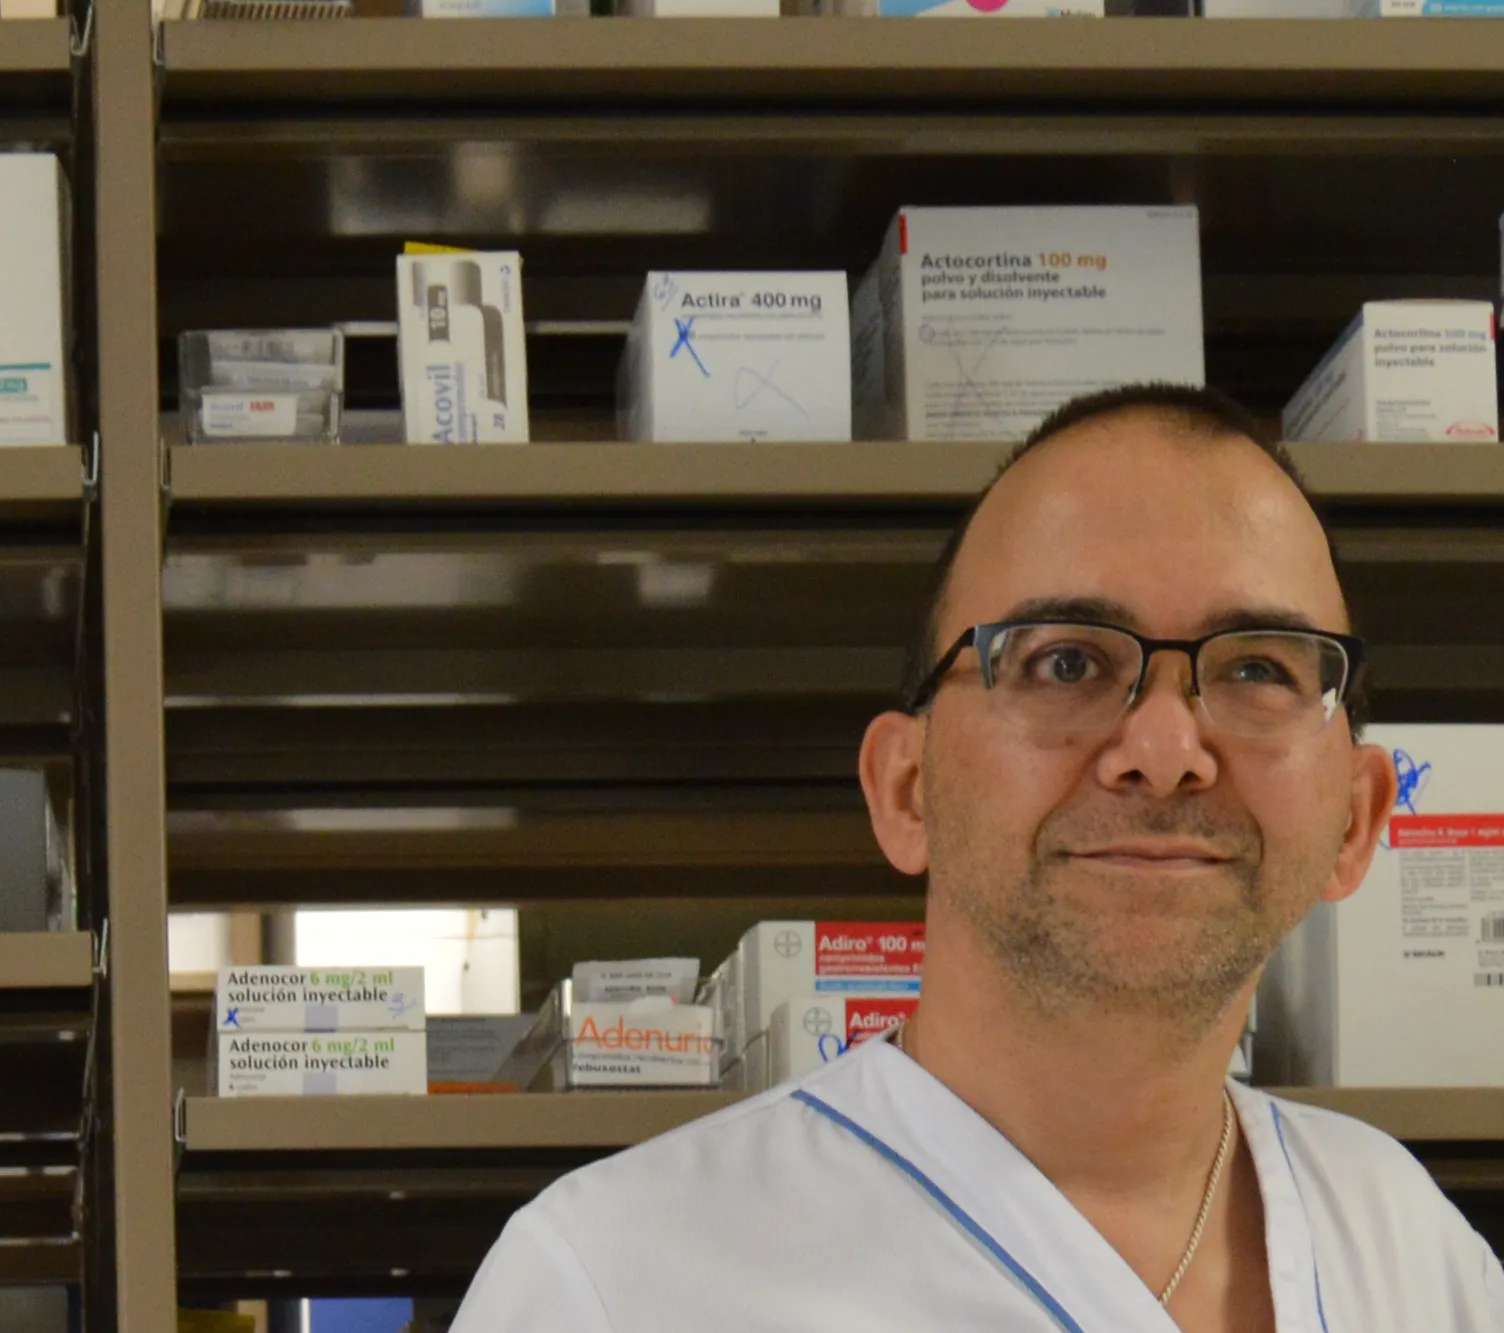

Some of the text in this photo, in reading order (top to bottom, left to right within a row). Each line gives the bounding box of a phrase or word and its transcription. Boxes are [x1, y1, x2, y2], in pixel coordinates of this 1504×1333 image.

[921, 251, 1108, 273] Actocortina 100 mg
[921, 272, 960, 287] polvo
[981, 270, 1060, 285] disolvente
[751, 293, 786, 309] 400
[790, 296, 823, 313] mg
[1025, 284, 1107, 303] inyectable
[878, 937, 907, 952] 100
[227, 970, 394, 991] Adenocor 6 mg/2 ml
[227, 987, 388, 1008] solución inyectable
[228, 1037, 395, 1058] Adenocor 6 mg/2 ml
[228, 1054, 389, 1074] solución inyectable
